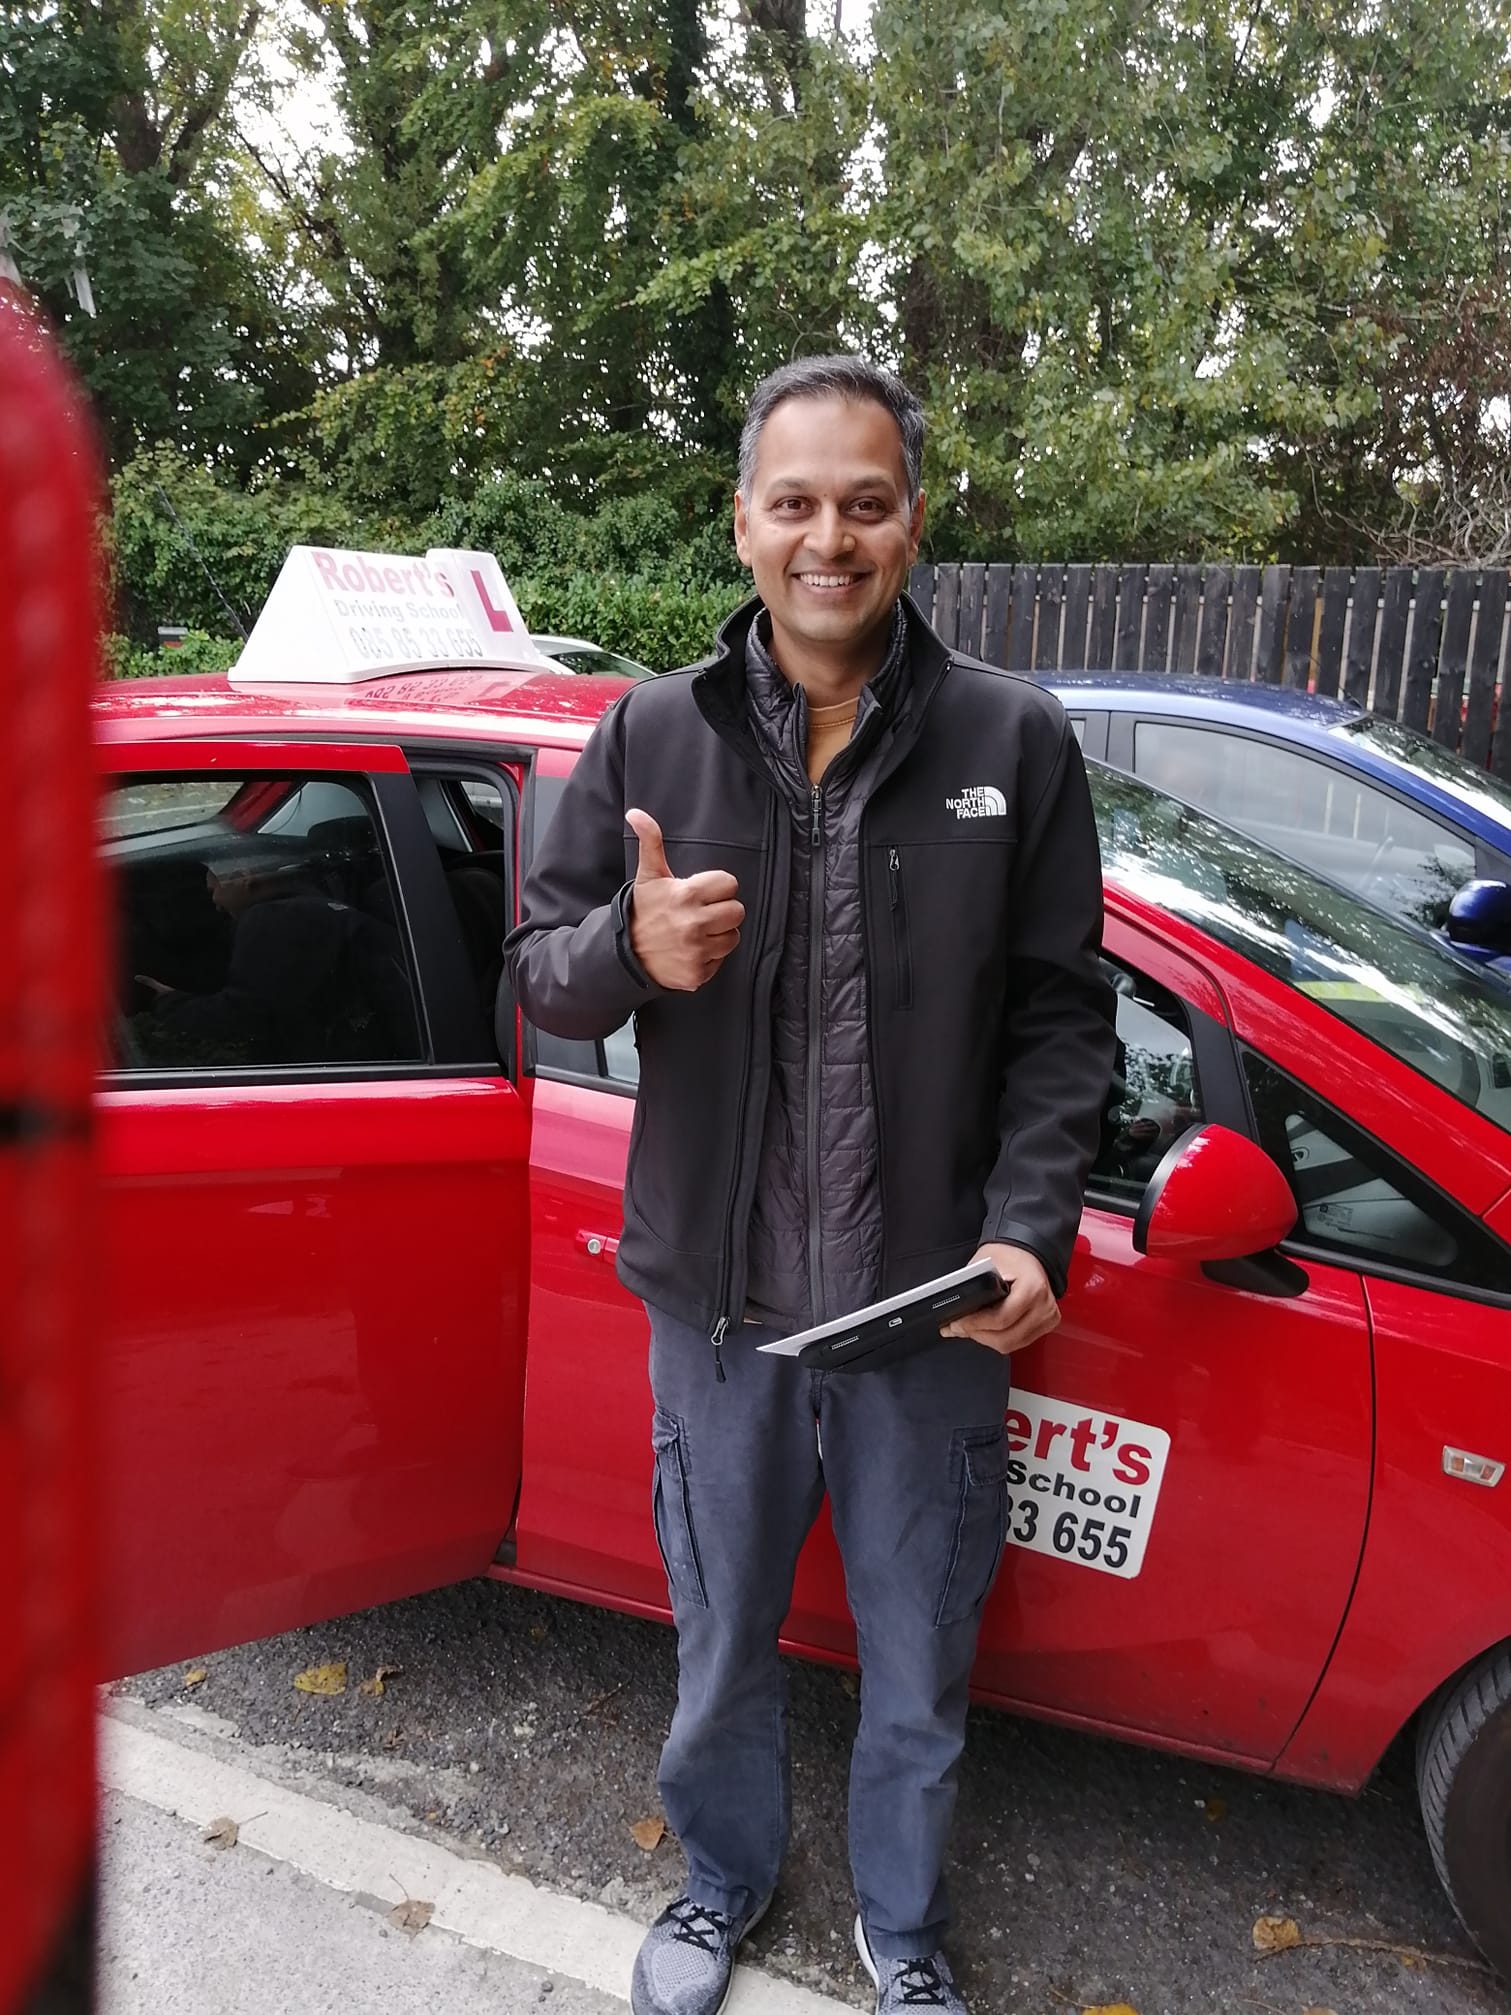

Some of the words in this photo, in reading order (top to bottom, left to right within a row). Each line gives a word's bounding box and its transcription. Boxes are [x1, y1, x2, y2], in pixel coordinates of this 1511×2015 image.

[310, 551, 455, 598] Robert's
[334, 599, 404, 622] Driving
[406, 600, 463, 620] School
[470, 570, 513, 632] L
[349, 626, 394, 659] 085
[390, 627, 422, 658] 85
[419, 627, 450, 657] 33
[446, 627, 484, 657] 655
[946, 797, 985, 809] NORTH
[961, 787, 984, 799] THE
[957, 807, 985, 820] FACE
[1005, 1409, 1152, 1486] ert's
[1006, 1459, 1141, 1518] School
[1052, 1511, 1131, 1568] 655
